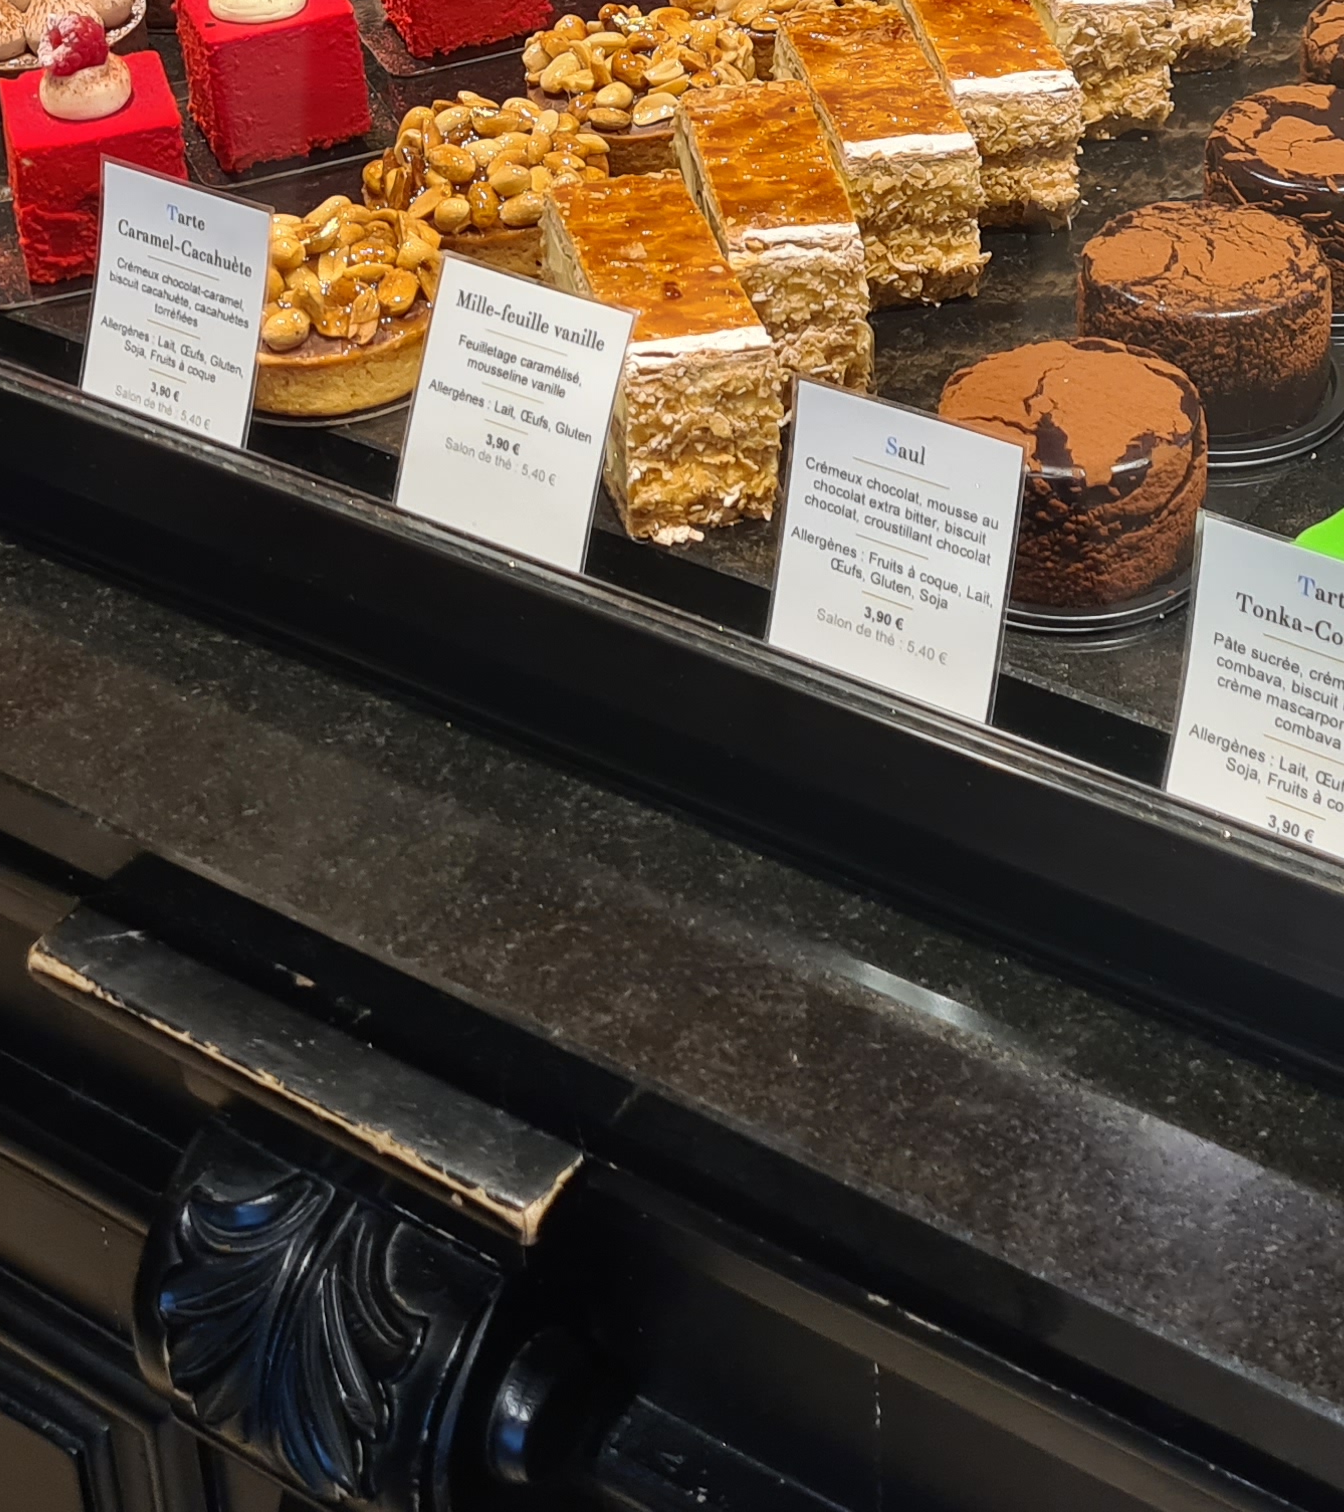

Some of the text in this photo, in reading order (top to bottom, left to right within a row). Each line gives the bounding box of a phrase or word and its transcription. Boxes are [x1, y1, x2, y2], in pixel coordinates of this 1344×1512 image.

[167, 204, 204, 231] Tarte
[118, 218, 251, 277] Caramel-Cacahuète
[117, 256, 159, 281] Crémeux
[109, 270, 138, 290] biscuit
[194, 302, 248, 328] cacahuètes
[154, 303, 197, 327] torréfiées
[100, 315, 149, 342] Allergènes
[456, 289, 604, 351] Mille-feuille vanille
[150, 349, 176, 368] Fruits
[178, 360, 184, 371] à
[187, 365, 215, 383] coque
[458, 334, 581, 386] Feuilletage caramélisé,
[467, 358, 565, 398] mousseline vanille
[114, 384, 141, 404] Salon
[143, 397, 155, 409] de
[157, 402, 172, 416] thé
[428, 378, 484, 407] Allergènes
[555, 421, 591, 444] Gluten
[444, 436, 475, 458] Salon
[477, 450, 491, 463] de
[494, 455, 511, 470] thé
[485, 433, 509, 451] 3,90
[885, 437, 925, 465] Saul
[805, 456, 998, 530] Crémeux chocolat, mousse au
[813, 479, 986, 545] chocolat extra bitter, biscuit
[804, 494, 990, 566] chocolat, croustillant chocolat
[790, 526, 992, 608] Allergènes Fruits à coque, Lait,
[870, 571, 914, 599] Gluten,
[919, 588, 948, 609] Soja
[816, 607, 852, 631] Salon
[855, 623, 872, 637] de
[875, 629, 895, 646] thé
[863, 606, 891, 626] 3,90
[1213, 631, 1246, 654] Pâte
[1250, 648, 1302, 678] sucrée,
[1216, 656, 1285, 690] combava,
[1291, 679, 1338, 709] biscuit
[1217, 676, 1261, 700] crème
[1188, 723, 1265, 762] Allergènes
[1279, 755, 1308, 781] Lait,
[1274, 716, 1341, 750] combava
[1225, 756, 1260, 784] Soja,
[1267, 771, 1308, 799] Fruits
[1312, 789, 1321, 805] à
[1268, 814, 1300, 838] 3,90
